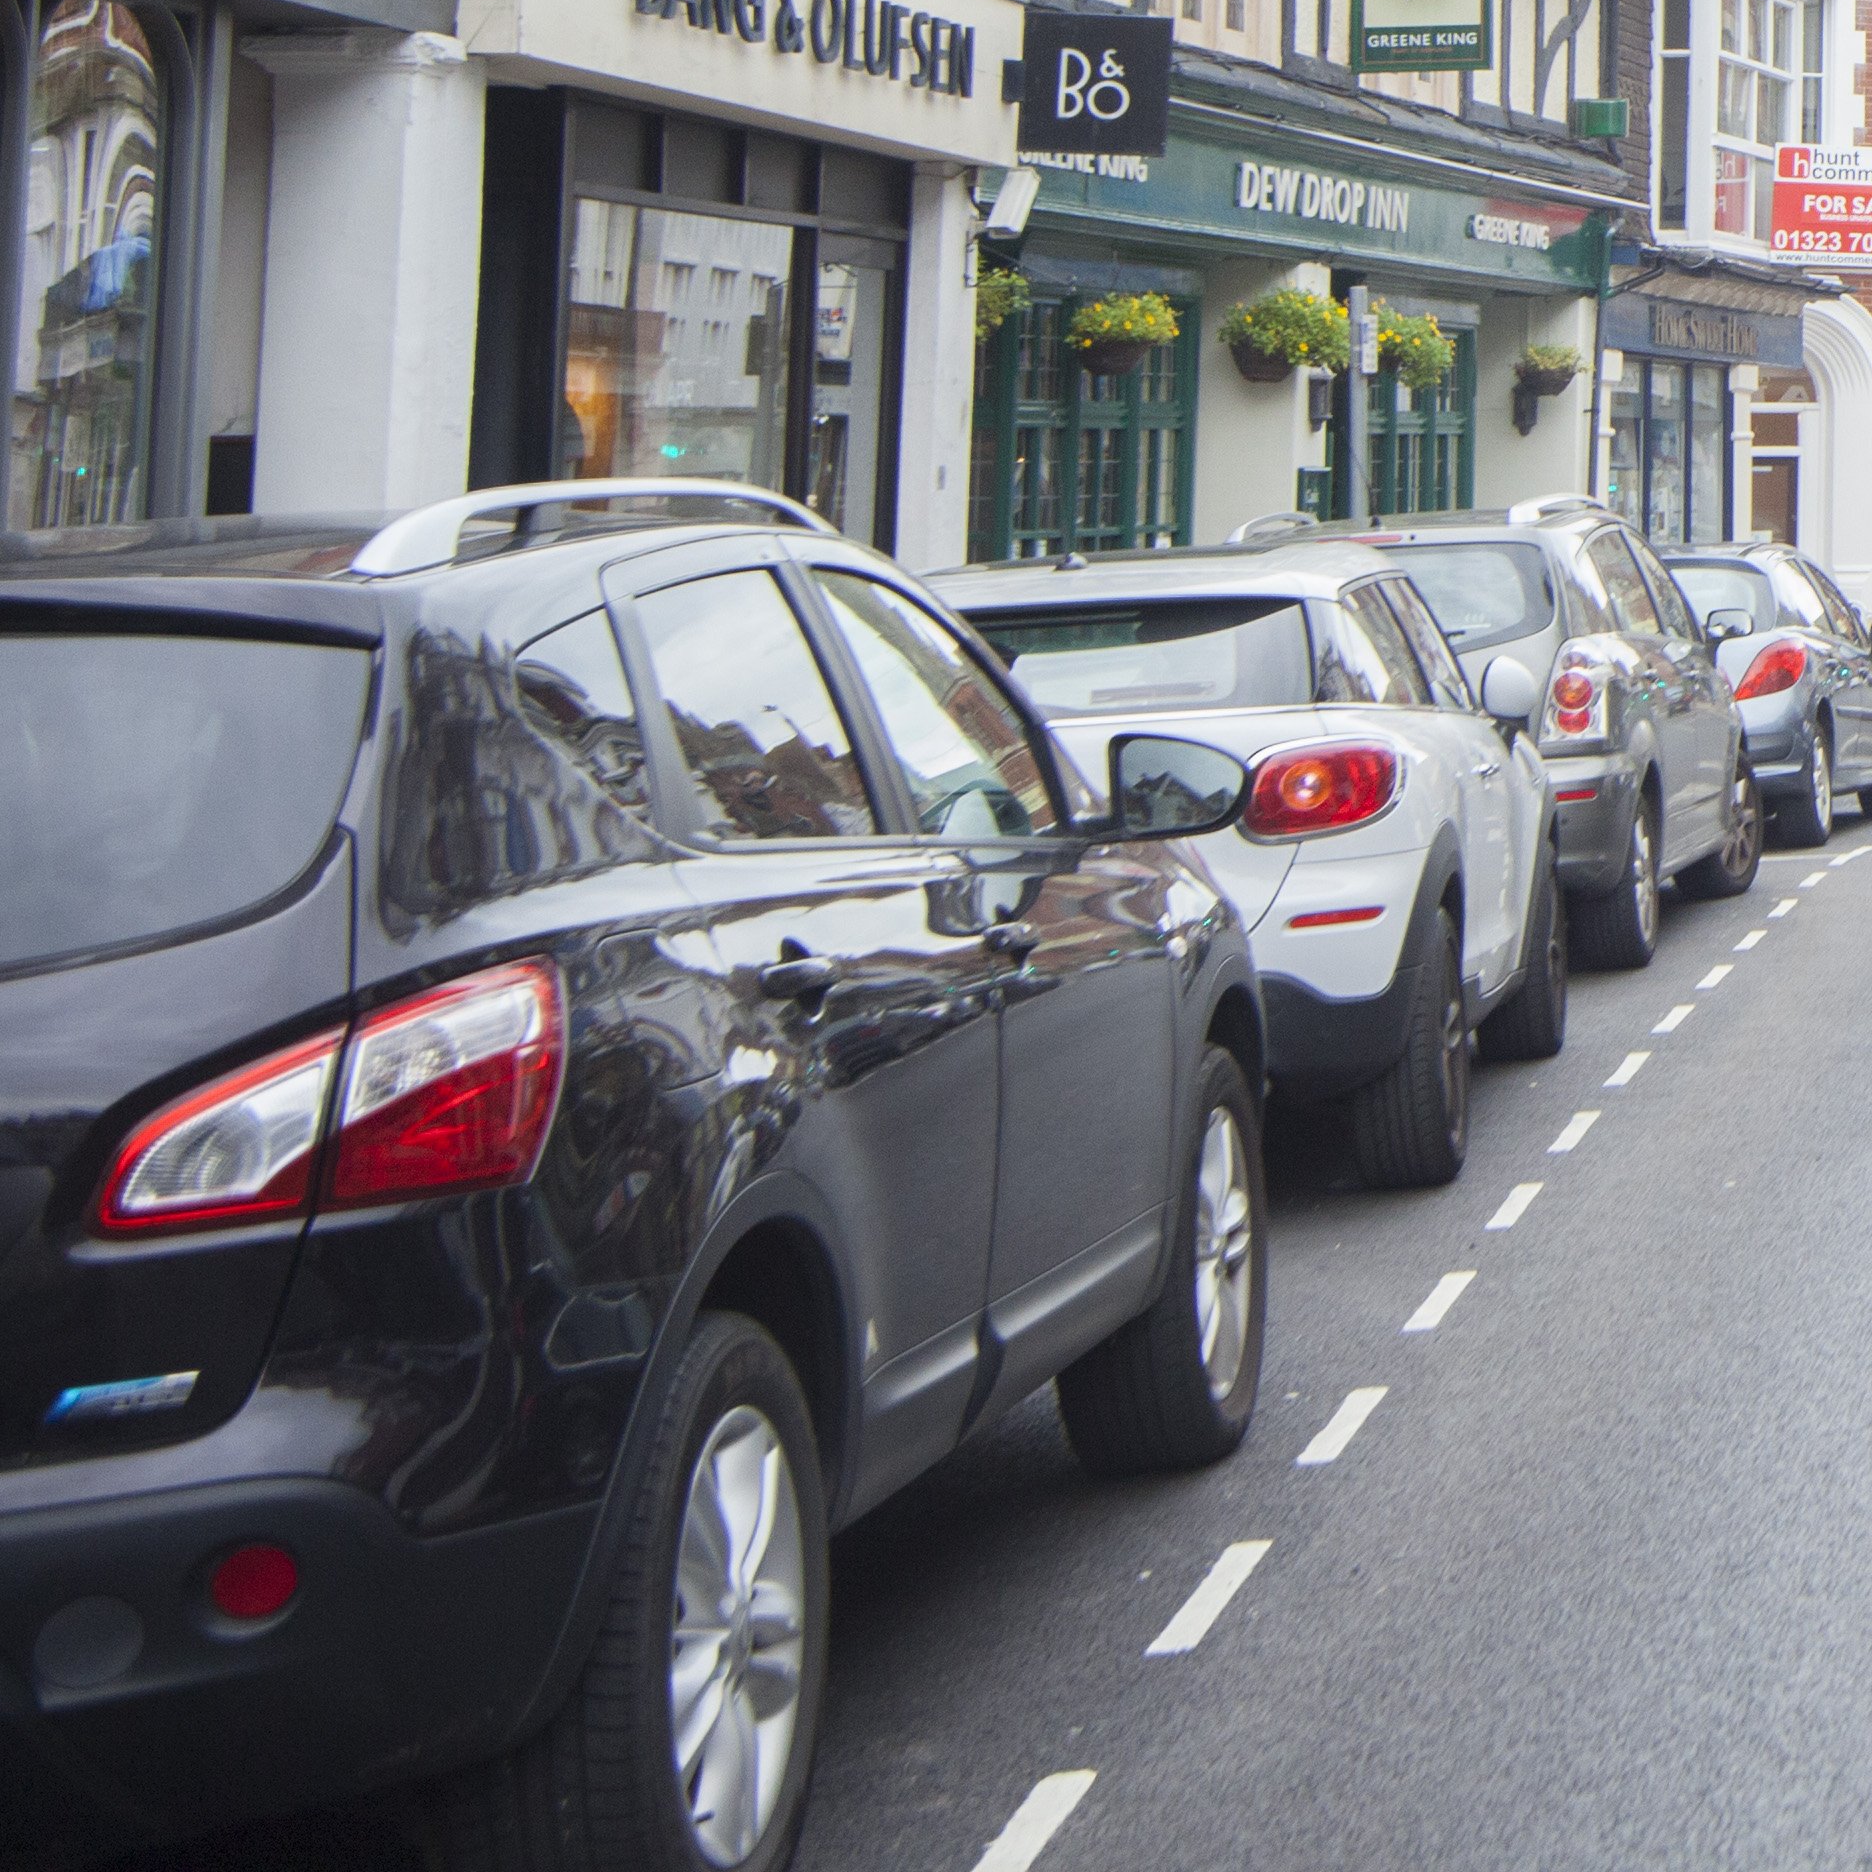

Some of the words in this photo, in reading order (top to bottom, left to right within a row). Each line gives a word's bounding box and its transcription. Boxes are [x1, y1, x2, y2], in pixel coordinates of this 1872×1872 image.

[1367, 33, 1431, 48] GREENE
[1436, 31, 1478, 46] KING
[1813, 149, 1860, 166] hunt
[1238, 161, 1300, 215] DEW
[1300, 172, 1365, 226] DROP
[1365, 185, 1409, 234] INN
[1803, 194, 1847, 214] FOR
[1468, 213, 1520, 247] GREENE
[1519, 221, 1550, 250] KING
[1774, 229, 1842, 251] 01323
